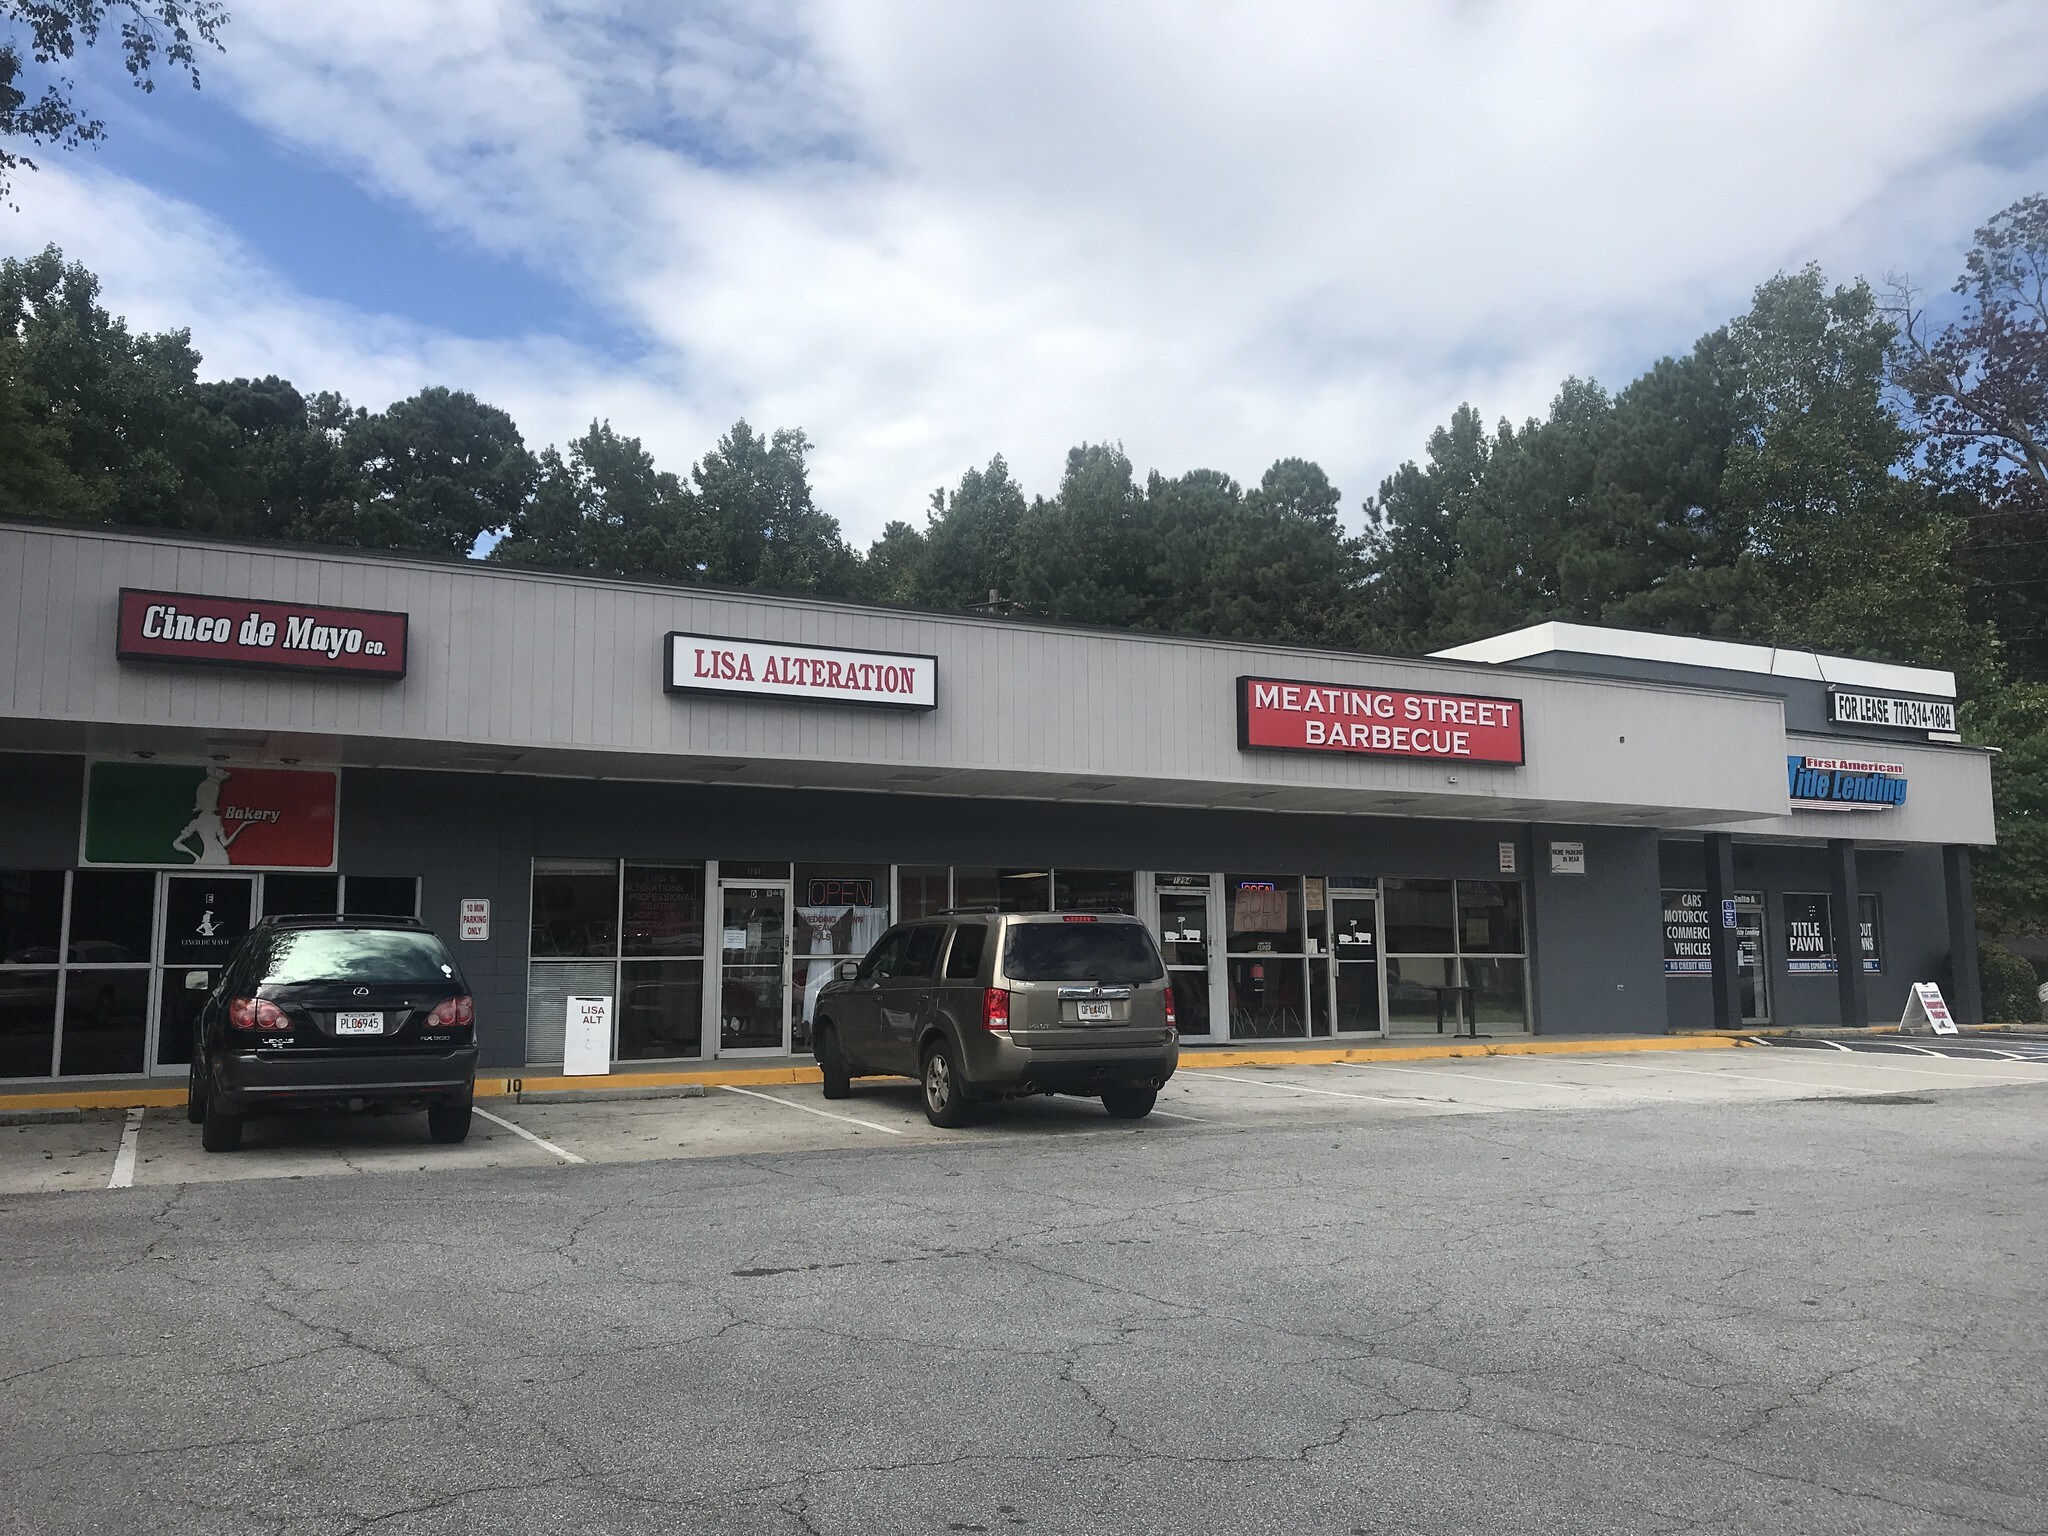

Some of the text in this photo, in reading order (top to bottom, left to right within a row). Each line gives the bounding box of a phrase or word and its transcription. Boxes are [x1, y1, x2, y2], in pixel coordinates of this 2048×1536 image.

[142, 605, 387, 660] Cinco de Mayo co.
[694, 648, 915, 694] LISA ALTERATION
[1254, 684, 1513, 728] MEATING STREET
[1839, 695, 1951, 728] FOR LEASE 770-314-1884
[1305, 720, 1471, 755] BARBECUE
[1807, 758, 1902, 773] First American
[1787, 756, 1908, 806] Title Lending
[225, 805, 281, 823] Bakery
[811, 881, 870, 906] OPEN
[1681, 894, 1702, 907] CARS
[466, 904, 484, 912] 10 MIN
[1237, 891, 1283, 914] SOLD
[463, 915, 487, 924] PARKING
[467, 926, 482, 935] ONLY
[1791, 922, 1821, 936] TITLE
[1673, 942, 1711, 956] VEHICLES
[1789, 937, 1824, 951] PAWN
[1679, 962, 1697, 970] CREDIT
[581, 1006, 605, 1014] LISA
[583, 1016, 603, 1024] ALT
[507, 1079, 522, 1093] 10
